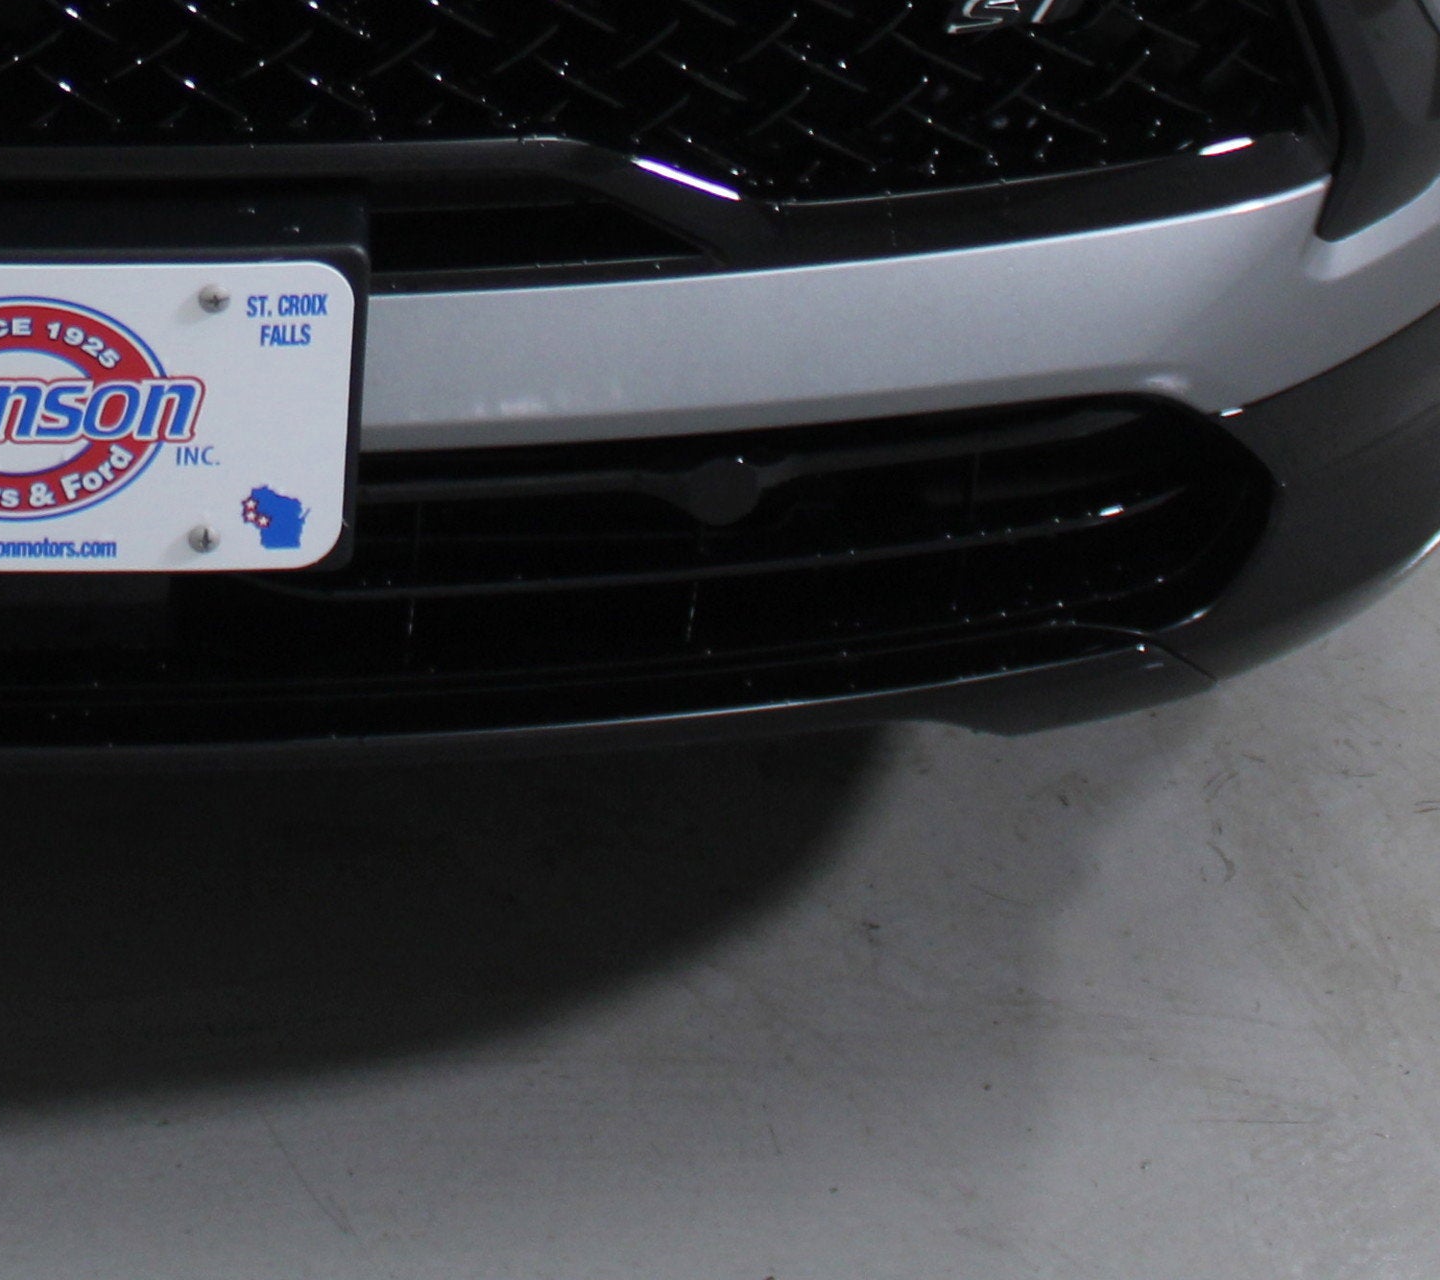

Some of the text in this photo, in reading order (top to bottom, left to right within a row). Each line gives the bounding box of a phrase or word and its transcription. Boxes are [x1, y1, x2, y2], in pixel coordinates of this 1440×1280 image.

[246, 294, 328, 318] ST. CROIX
[46, 321, 122, 370] 1925
[260, 324, 311, 346] FALLS
[176, 446, 220, 466] INC.
[28, 481, 55, 507] &
[60, 443, 134, 501] Ford
